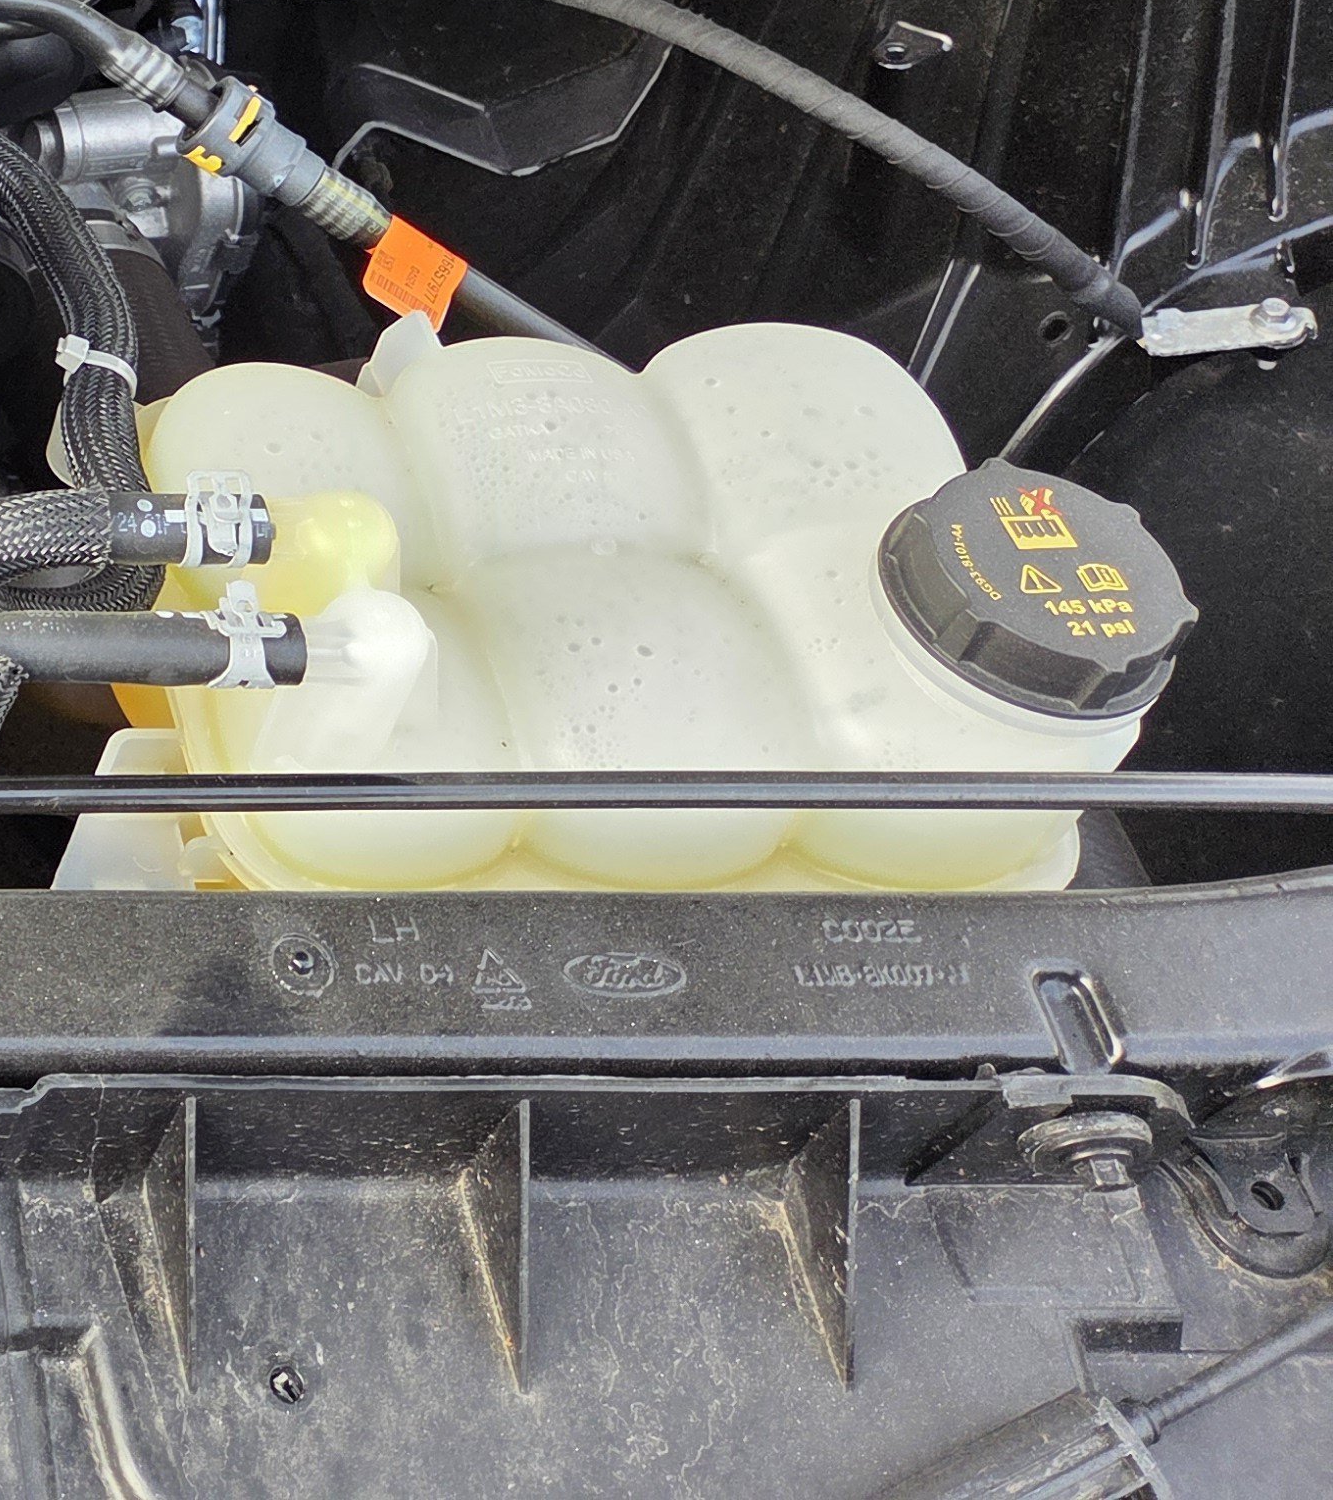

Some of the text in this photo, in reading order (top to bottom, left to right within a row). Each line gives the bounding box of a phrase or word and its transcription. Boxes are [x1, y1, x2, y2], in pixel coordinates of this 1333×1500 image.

[950, 523, 1002, 601] DG93-8101-AA
[1044, 599, 1133, 616] 145 kPa
[1067, 619, 1136, 638] 21 psi
[367, 914, 420, 943] LH
[355, 963, 404, 985] CAV
